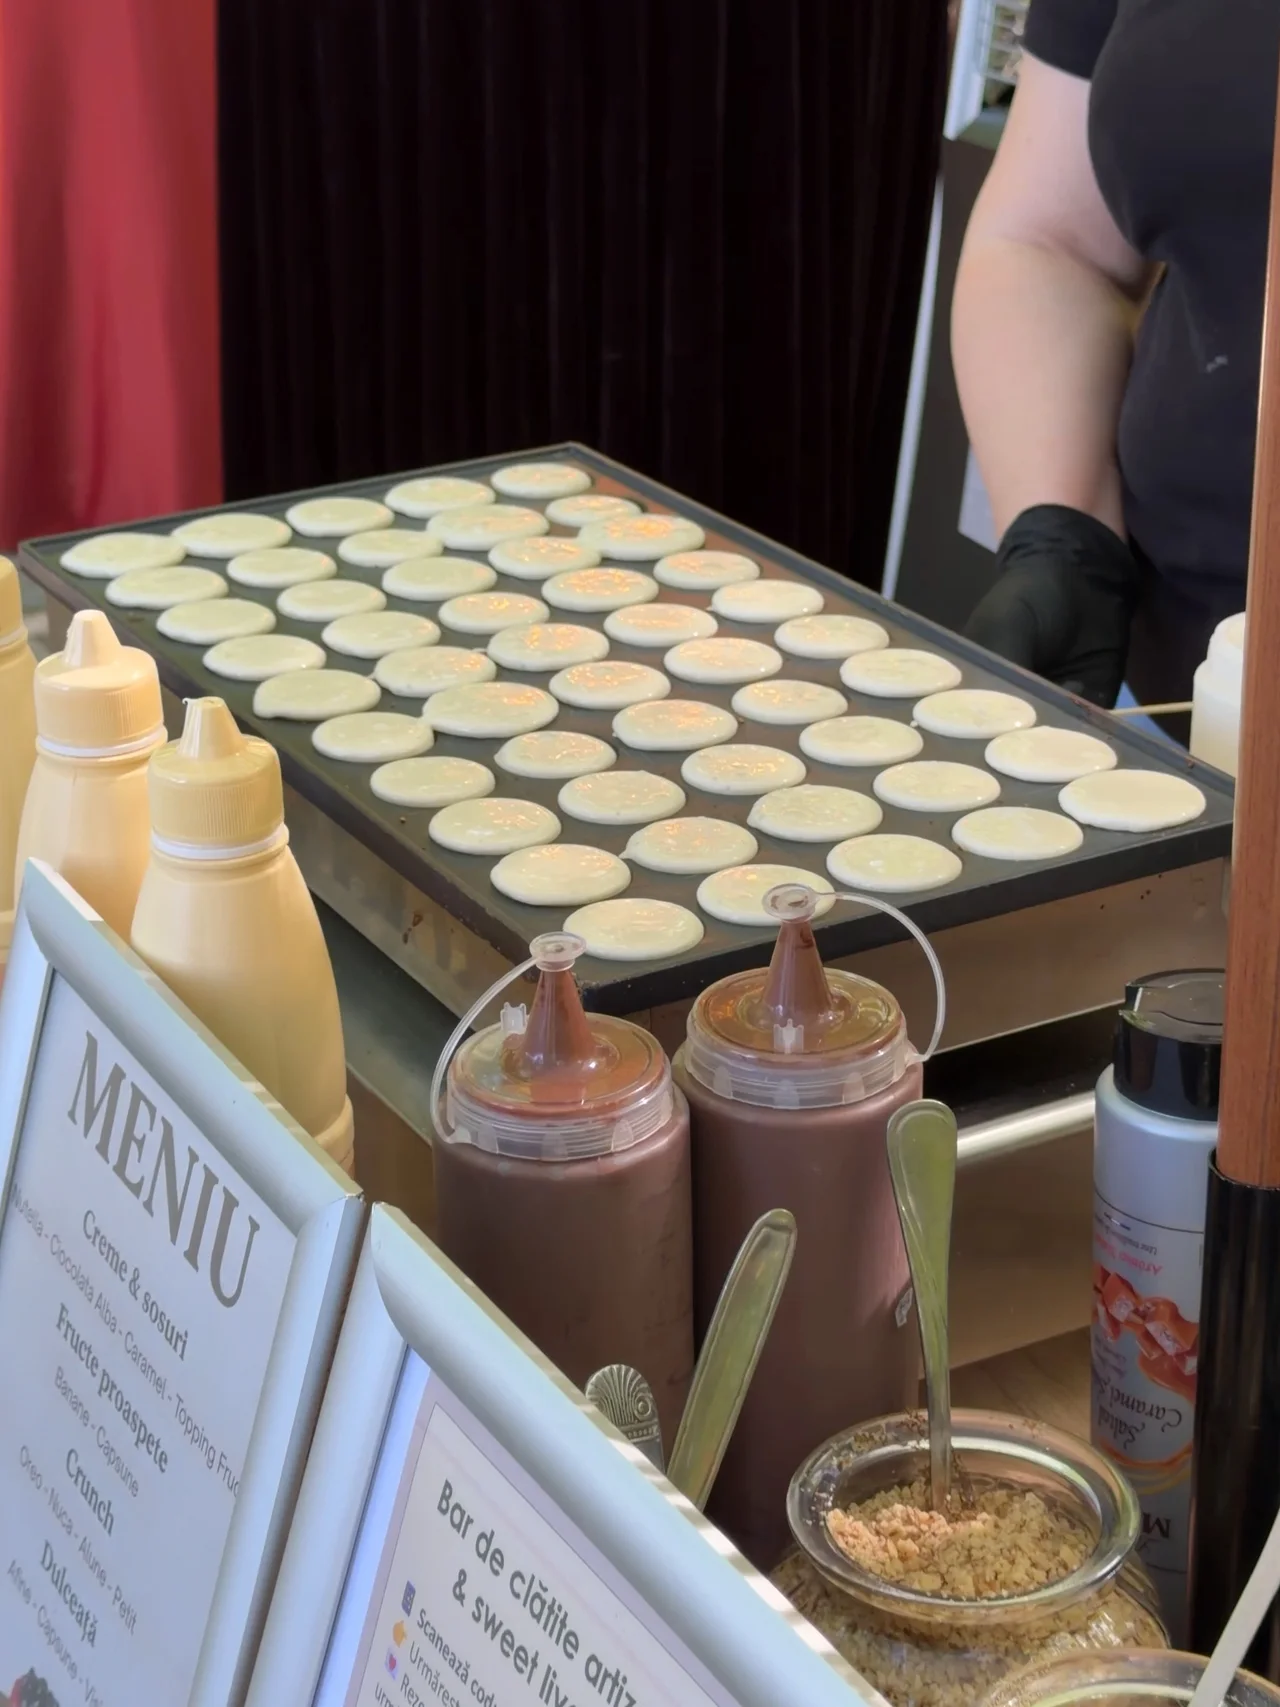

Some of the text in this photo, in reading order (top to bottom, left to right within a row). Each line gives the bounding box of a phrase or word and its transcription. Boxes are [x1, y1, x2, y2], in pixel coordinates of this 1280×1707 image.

[67, 1030, 260, 1308] MENIU
[50, 1233, 94, 1303] Ciocolata
[94, 1292, 118, 1334] Alba
[124, 1331, 167, 1400] Caramel
[174, 1393, 216, 1470] Topping
[83, 1209, 189, 1361] Creme & sosuri
[54, 1365, 90, 1427] Banane
[96, 1425, 139, 1497] Capsune
[55, 1302, 168, 1474] Fructe proaspete
[1110, 1386, 1182, 1433] Caramel
[20, 1445, 43, 1490] Oreo
[48, 1487, 74, 1536] Nuca
[78, 1536, 107, 1588] Alune
[112, 1585, 137, 1636] Petit
[66, 1448, 115, 1536] Crunch
[437, 1479, 474, 1539] Bar
[475, 1529, 504, 1576] de
[509, 1570, 579, 1660] clătite
[452, 1568, 576, 1707] & sweet liv
[417, 1608, 497, 1707] Scanează cod
